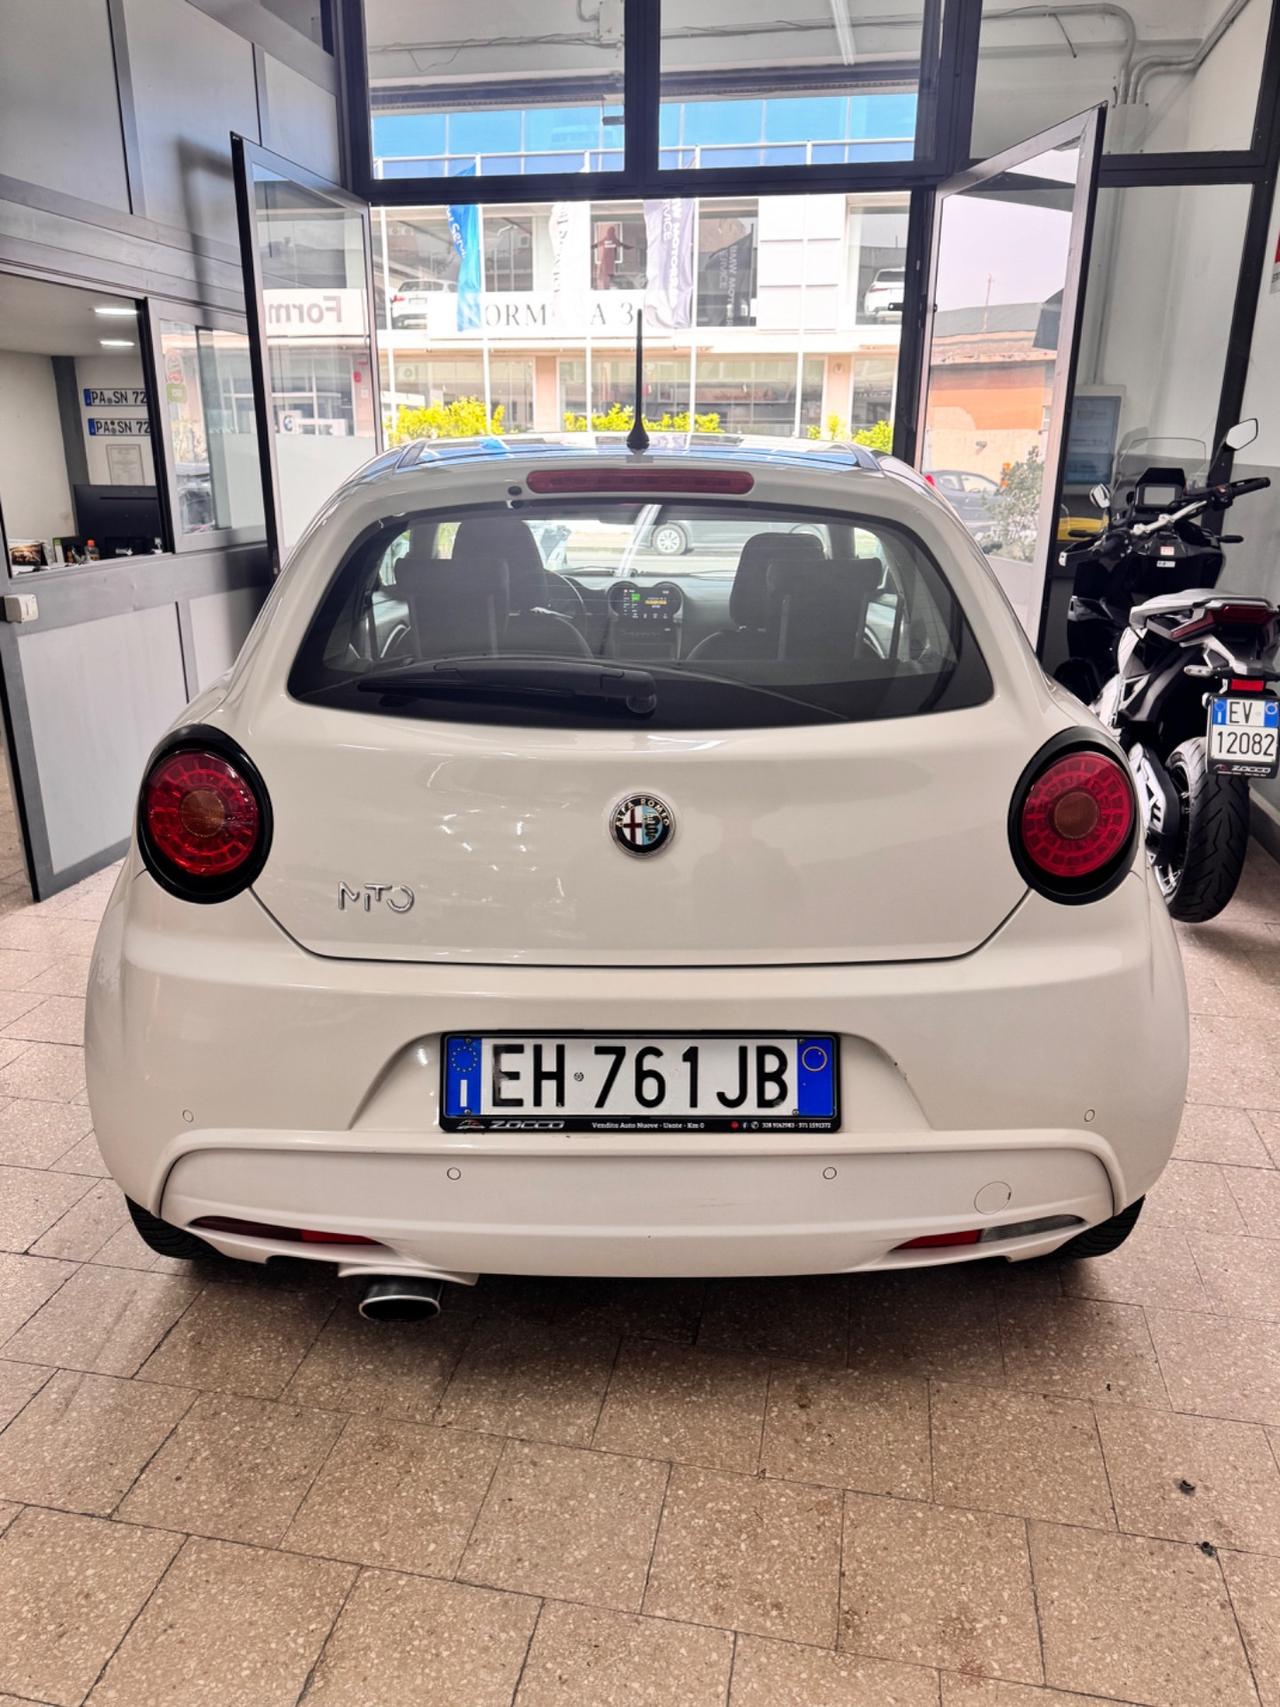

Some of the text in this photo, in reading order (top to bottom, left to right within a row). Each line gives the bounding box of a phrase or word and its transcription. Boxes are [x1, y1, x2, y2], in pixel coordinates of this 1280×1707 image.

[620, 302, 635, 326] 3
[92, 391, 106, 404] PA
[113, 391, 128, 404] SN
[96, 420, 110, 433] PA
[117, 420, 132, 433] SN
[1229, 702, 1253, 724] EV
[1217, 731, 1275, 757] 12082
[491, 1043, 789, 1109] EH 761 JB
[459, 1079, 468, 1107] I
[489, 1120, 565, 1129] ZOCCO
